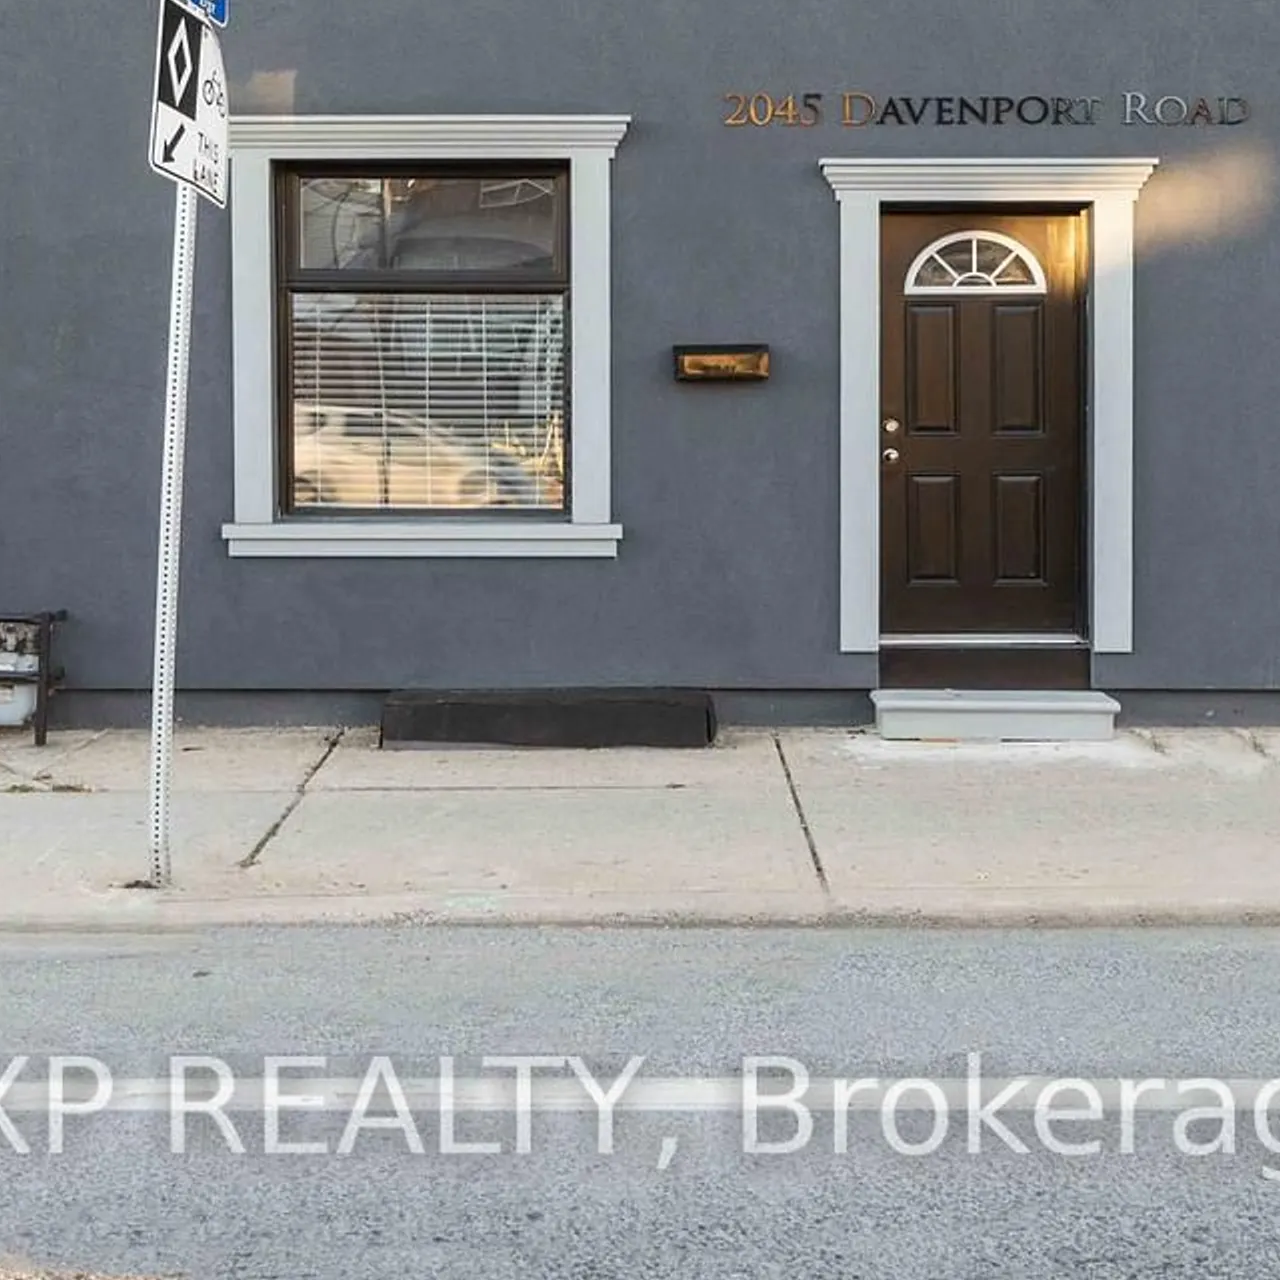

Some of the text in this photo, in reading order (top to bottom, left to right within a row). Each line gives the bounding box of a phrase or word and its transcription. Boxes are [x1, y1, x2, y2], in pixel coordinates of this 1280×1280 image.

[724, 91, 1250, 127] 2045 DAVENPORT ROAD
